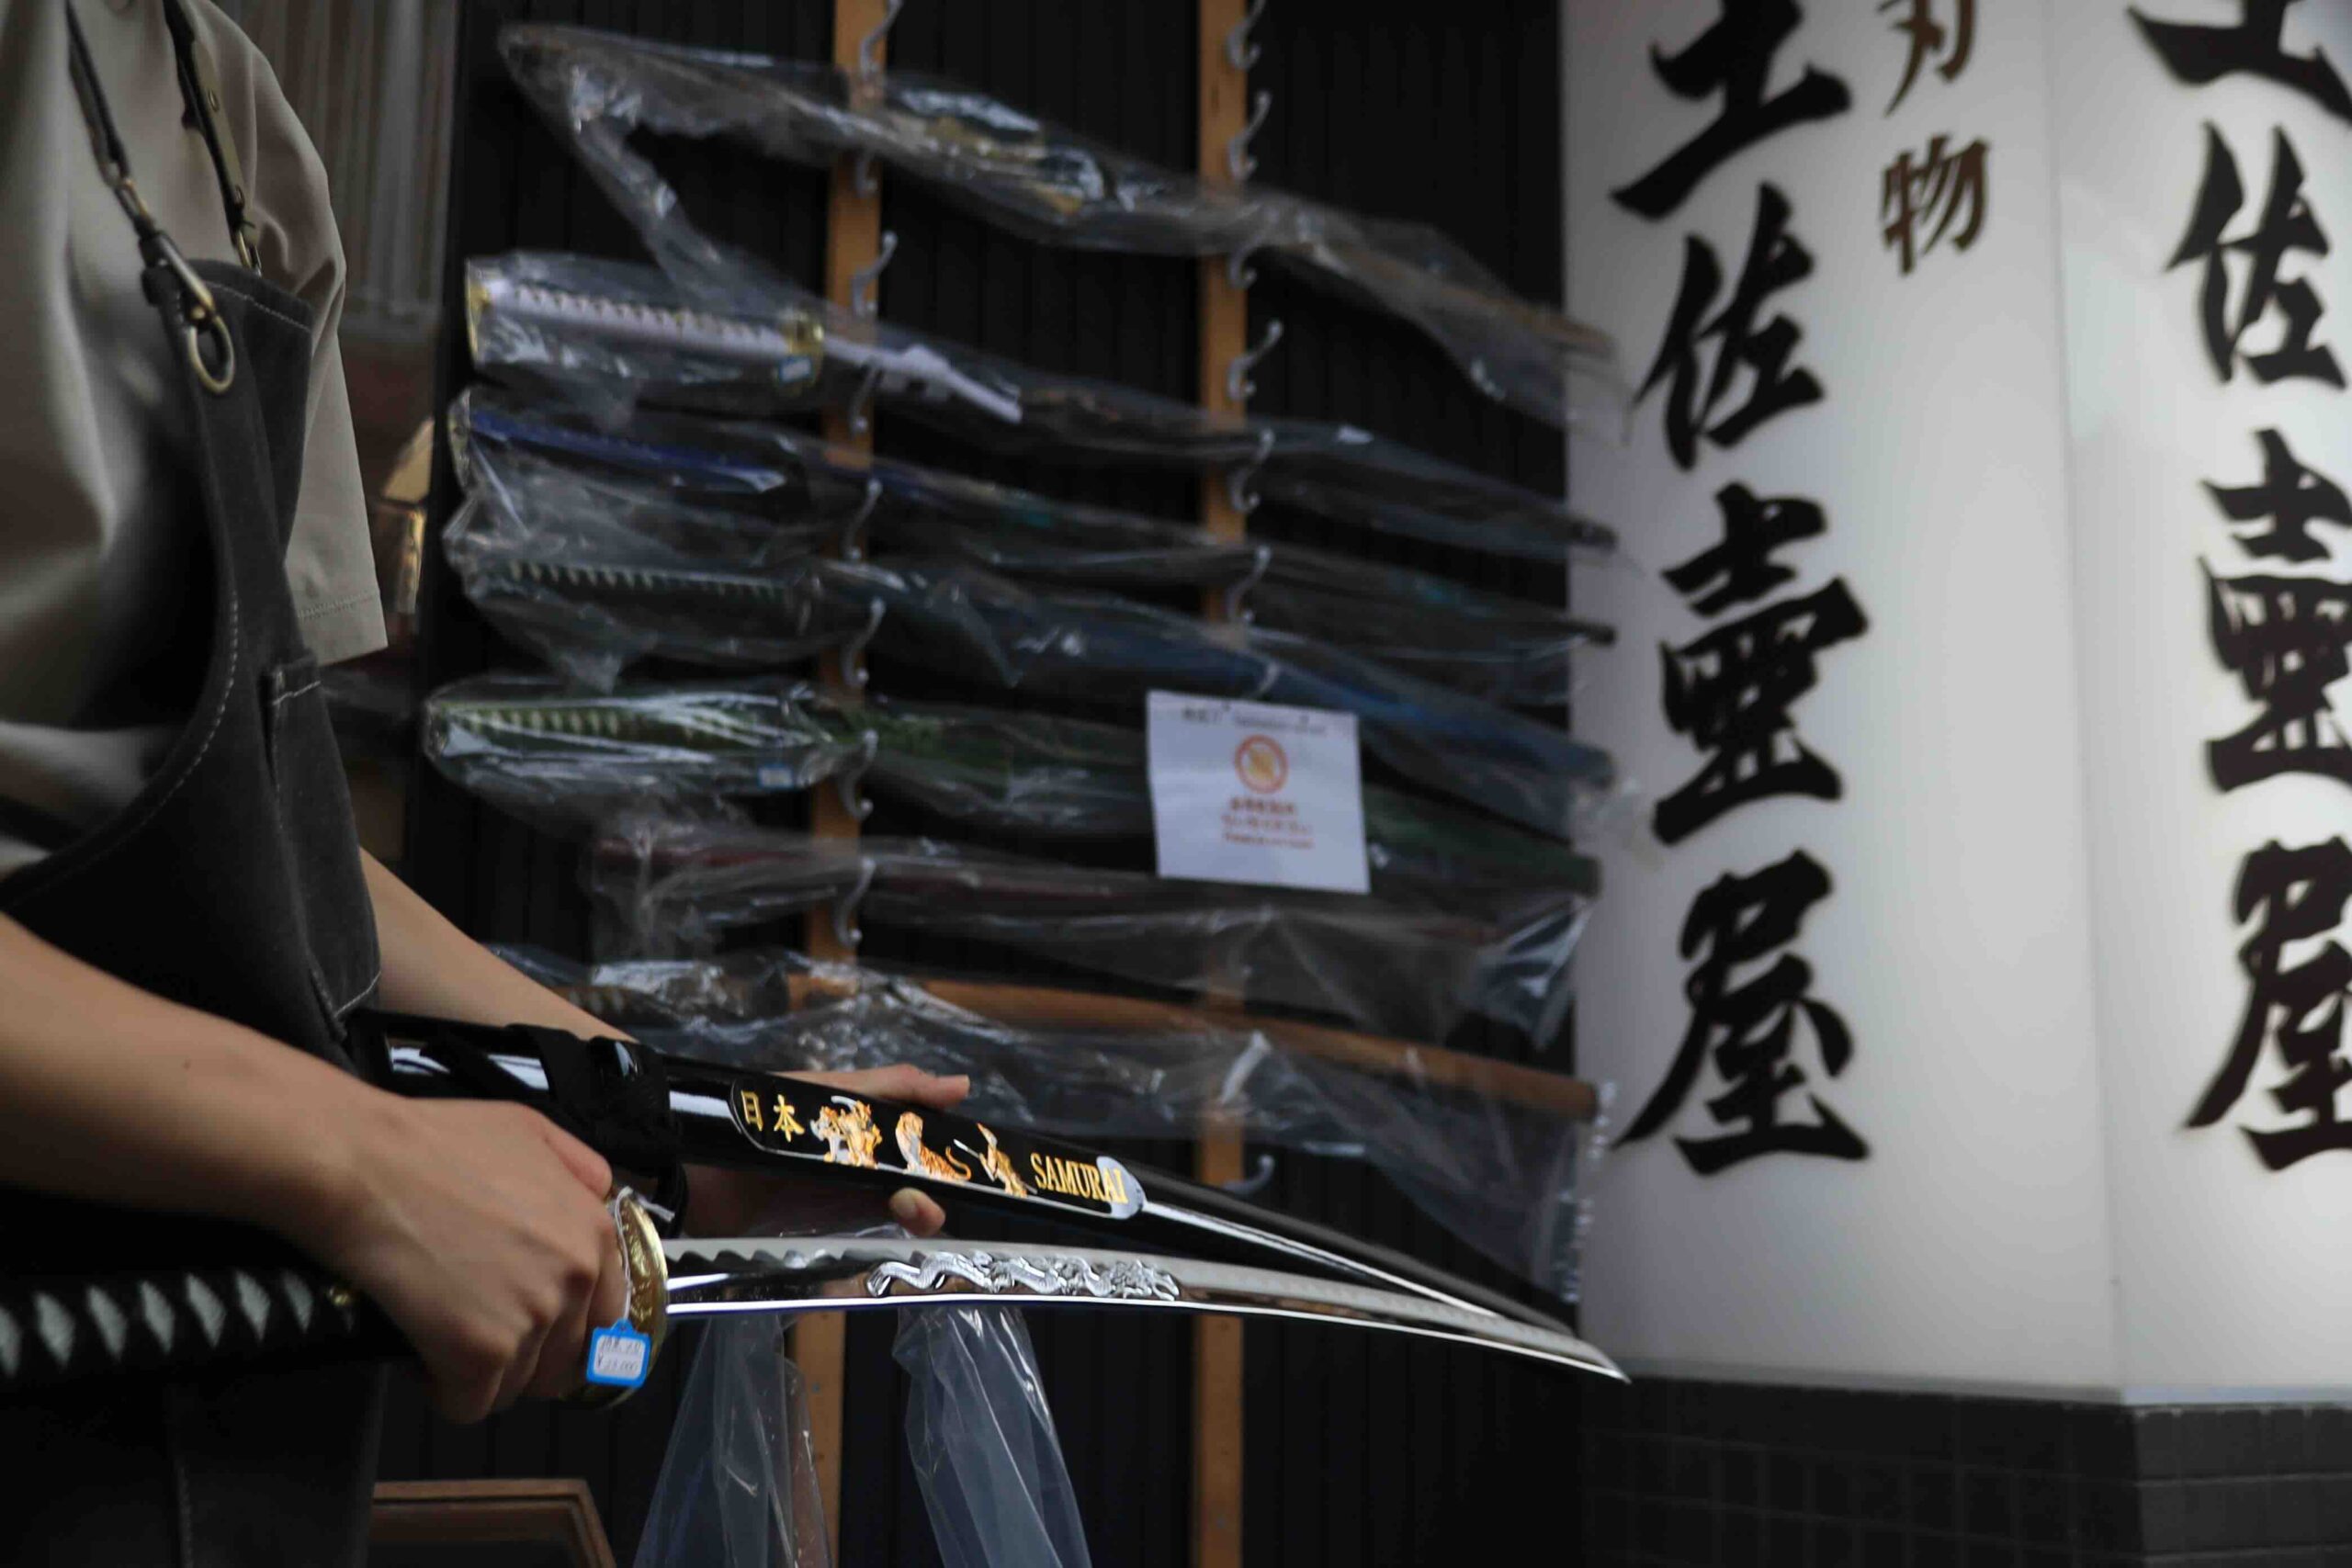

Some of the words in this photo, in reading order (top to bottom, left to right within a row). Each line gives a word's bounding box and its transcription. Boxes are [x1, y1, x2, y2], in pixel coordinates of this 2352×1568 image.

[1878, 0, 1989, 274] 刃物
[740, 1090, 806, 1143] 日本
[1030, 1152, 1129, 1205] SAMURAI
